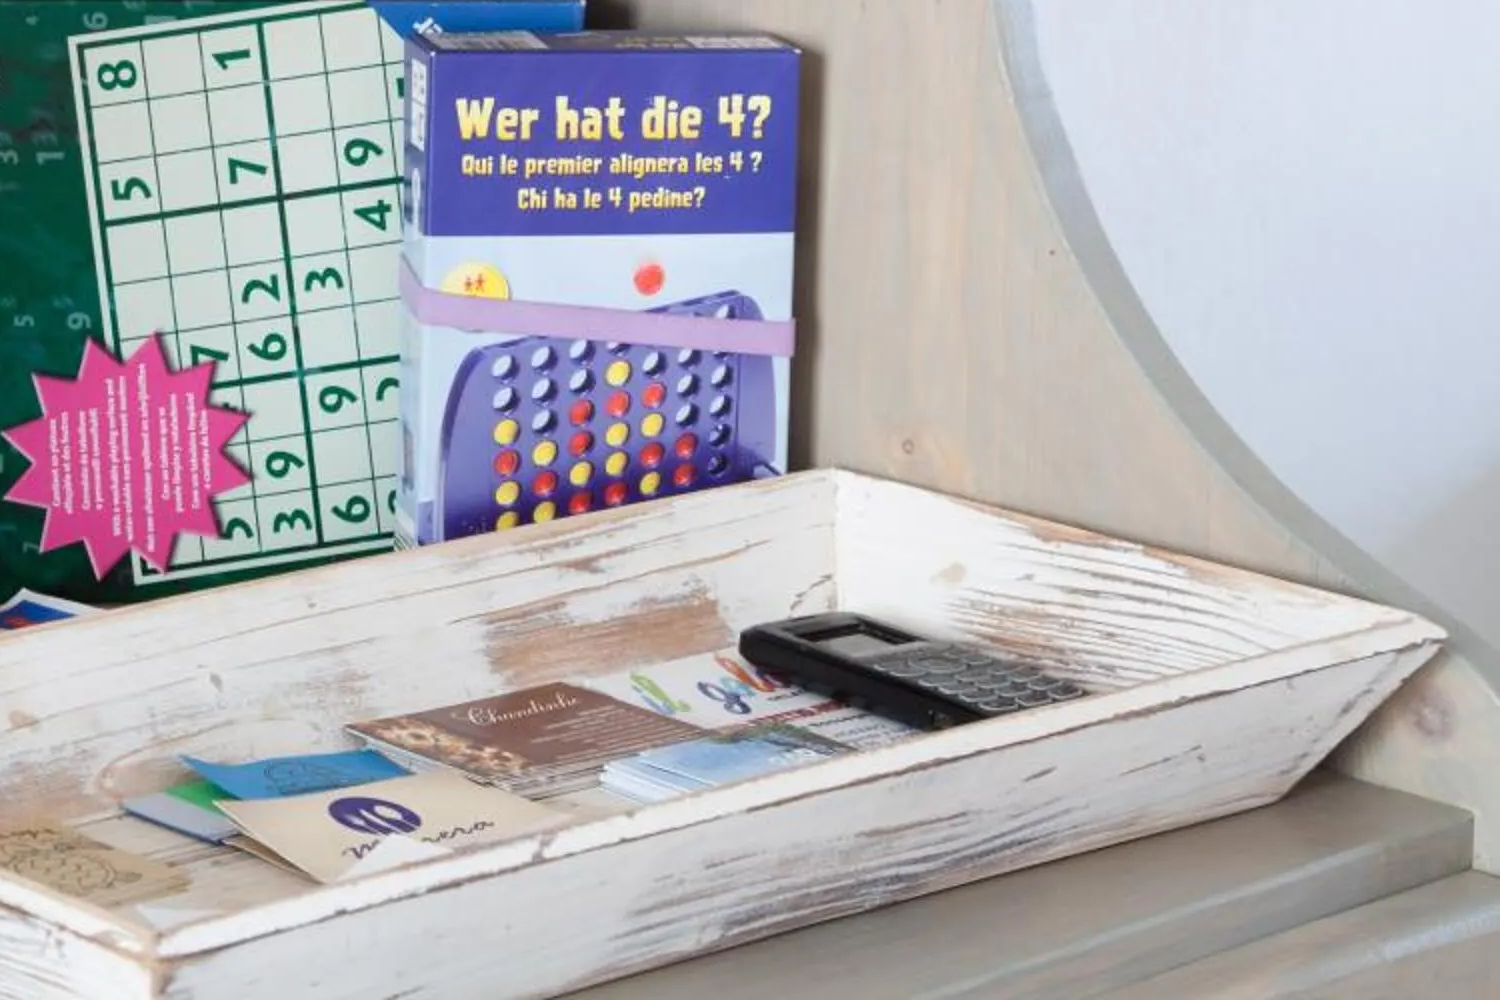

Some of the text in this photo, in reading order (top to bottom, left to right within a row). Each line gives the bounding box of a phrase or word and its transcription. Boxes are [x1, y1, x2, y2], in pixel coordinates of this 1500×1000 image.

[212, 49, 250, 70] 1
[97, 60, 137, 91] 8
[456, 97, 539, 140] Wer
[556, 95, 626, 140] hat
[641, 95, 703, 139] die
[718, 94, 772, 139] 4?
[344, 138, 383, 167] 9
[461, 154, 493, 176] Qui
[500, 152, 518, 175] le
[525, 154, 602, 179] premier
[609, 153, 688, 179] alignera
[696, 152, 723, 173] les
[728, 152, 743, 172] 4
[228, 157, 268, 185] 7
[111, 177, 153, 200] 5
[518, 187, 705, 213] Chi ha le 4 pedine?
[354, 199, 392, 231] 4
[241, 274, 281, 304] 2
[304, 267, 344, 292] 3
[247, 332, 287, 361] 6
[319, 385, 358, 413] 9
[265, 451, 304, 478] 9
[273, 508, 312, 533] 3
[331, 495, 370, 523] 6
